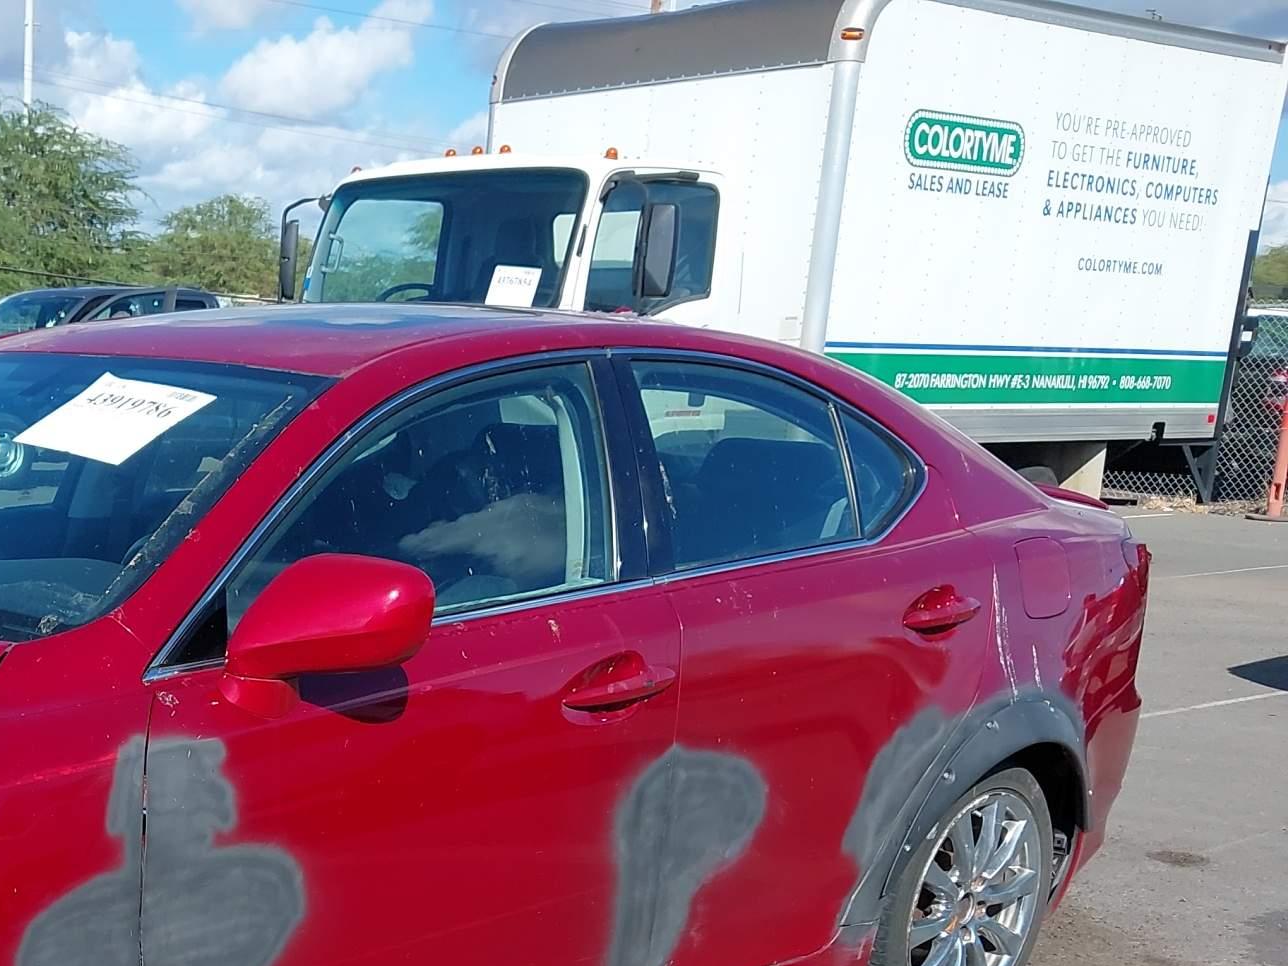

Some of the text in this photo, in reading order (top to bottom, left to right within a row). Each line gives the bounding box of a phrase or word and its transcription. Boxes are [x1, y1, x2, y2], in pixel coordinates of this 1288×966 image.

[914, 122, 1017, 164] COLORTYME
[1055, 111, 1192, 148] YOU'RE PRE-APPROVED
[1051, 140, 1199, 179] TO GET THE FURNITURE,
[908, 172, 1010, 199] SALES AND LEASE
[1047, 170, 1219, 206] ELECTRONICS, COMPUTERS
[1042, 199, 1205, 232] & APPLIANCES YOU NEED!
[1077, 257, 1163, 275] COLORTYME.COM
[894, 373, 930, 389] 87-2070
[930, 373, 987, 389] FARRINGTON
[987, 374, 1012, 389] HWY
[1031, 374, 1076, 391] NANAKULI,
[1077, 375, 1088, 389] HI
[1087, 375, 1111, 389] 96792
[1119, 376, 1172, 390] 808-668-7070
[86, 392, 178, 419] 43919786
